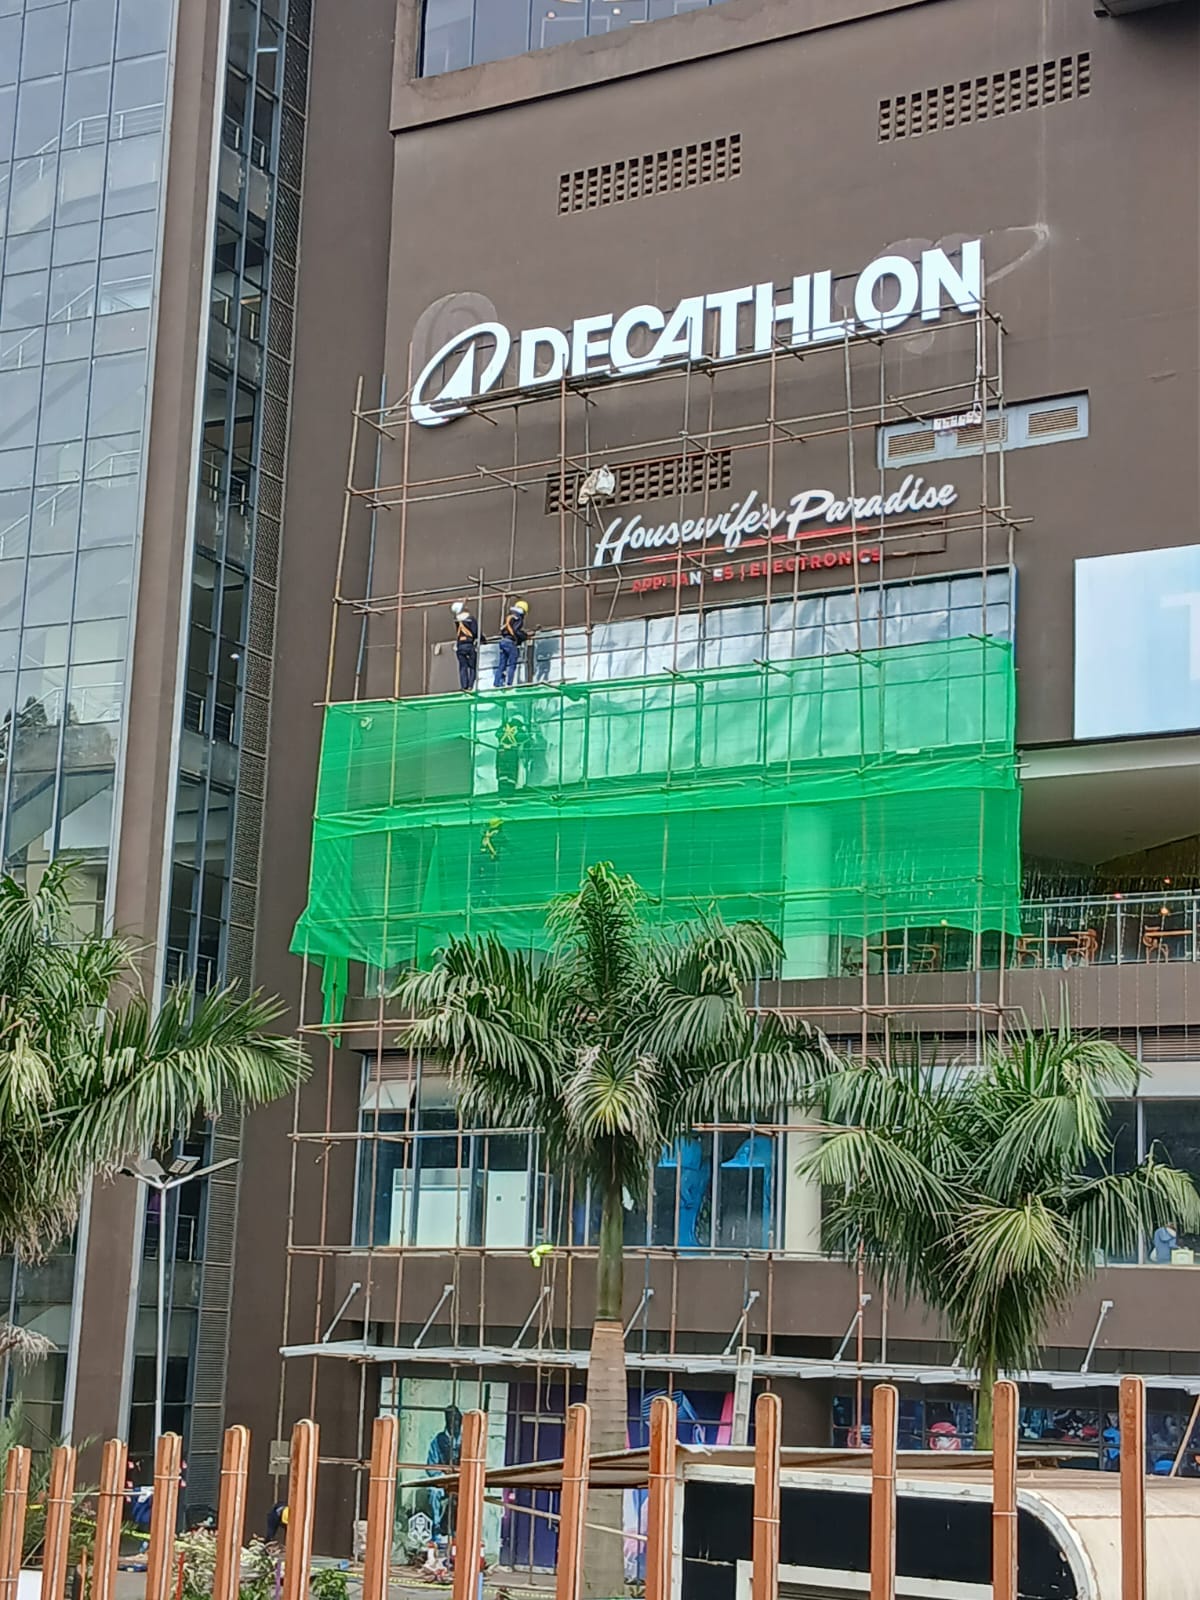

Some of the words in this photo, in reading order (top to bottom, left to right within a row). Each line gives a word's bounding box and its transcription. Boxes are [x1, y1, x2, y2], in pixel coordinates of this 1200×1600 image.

[518, 239, 981, 388] DECATHLON
[593, 490, 786, 567] Housewife's
[785, 474, 958, 540] Paradise
[749, 547, 880, 577] ELECTRONCS
